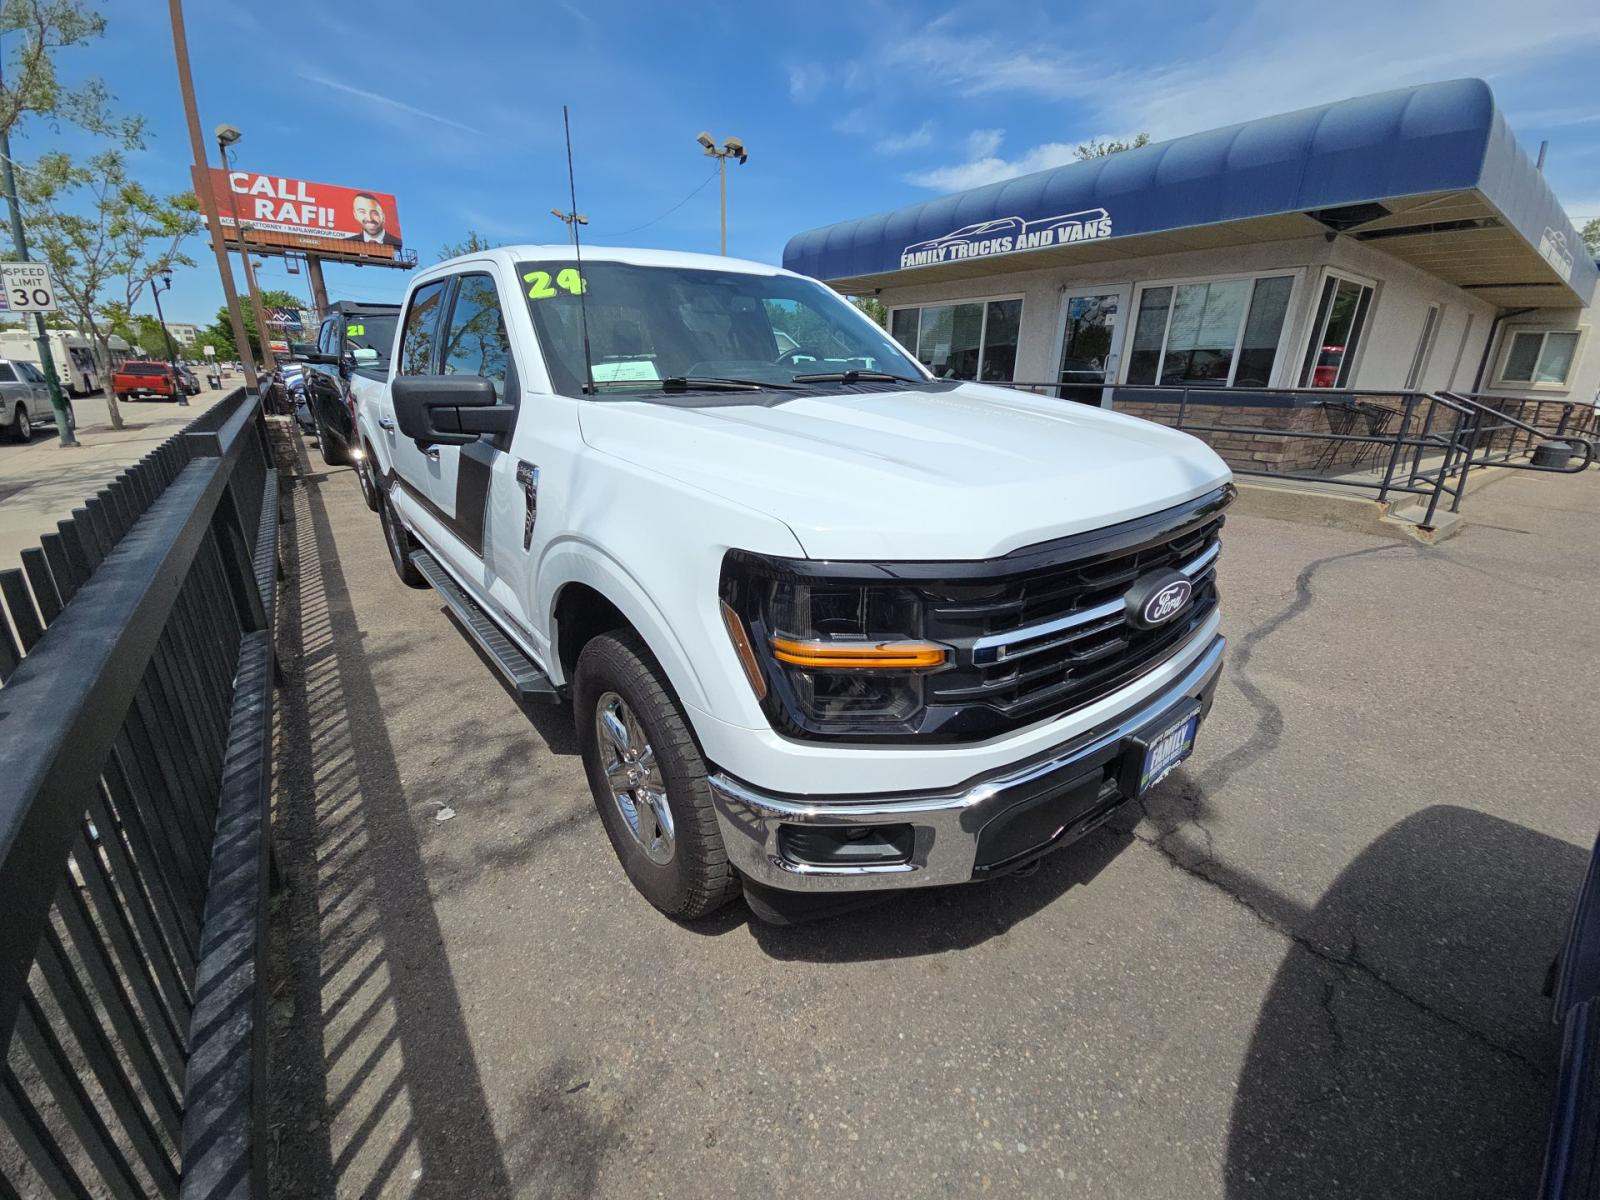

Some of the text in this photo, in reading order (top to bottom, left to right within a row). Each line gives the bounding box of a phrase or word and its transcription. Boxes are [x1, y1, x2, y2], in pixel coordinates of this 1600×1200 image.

[229, 172, 316, 203] CALL
[254, 199, 335, 228] RAFI!
[901, 220, 1113, 268] FAMILY TRUCKS AND VANS
[3, 268, 45, 276] SPEED
[11, 278, 42, 287] LIMIT
[523, 268, 587, 299] 24
[12, 288, 50, 306] 30
[1154, 587, 1185, 618] Ford
